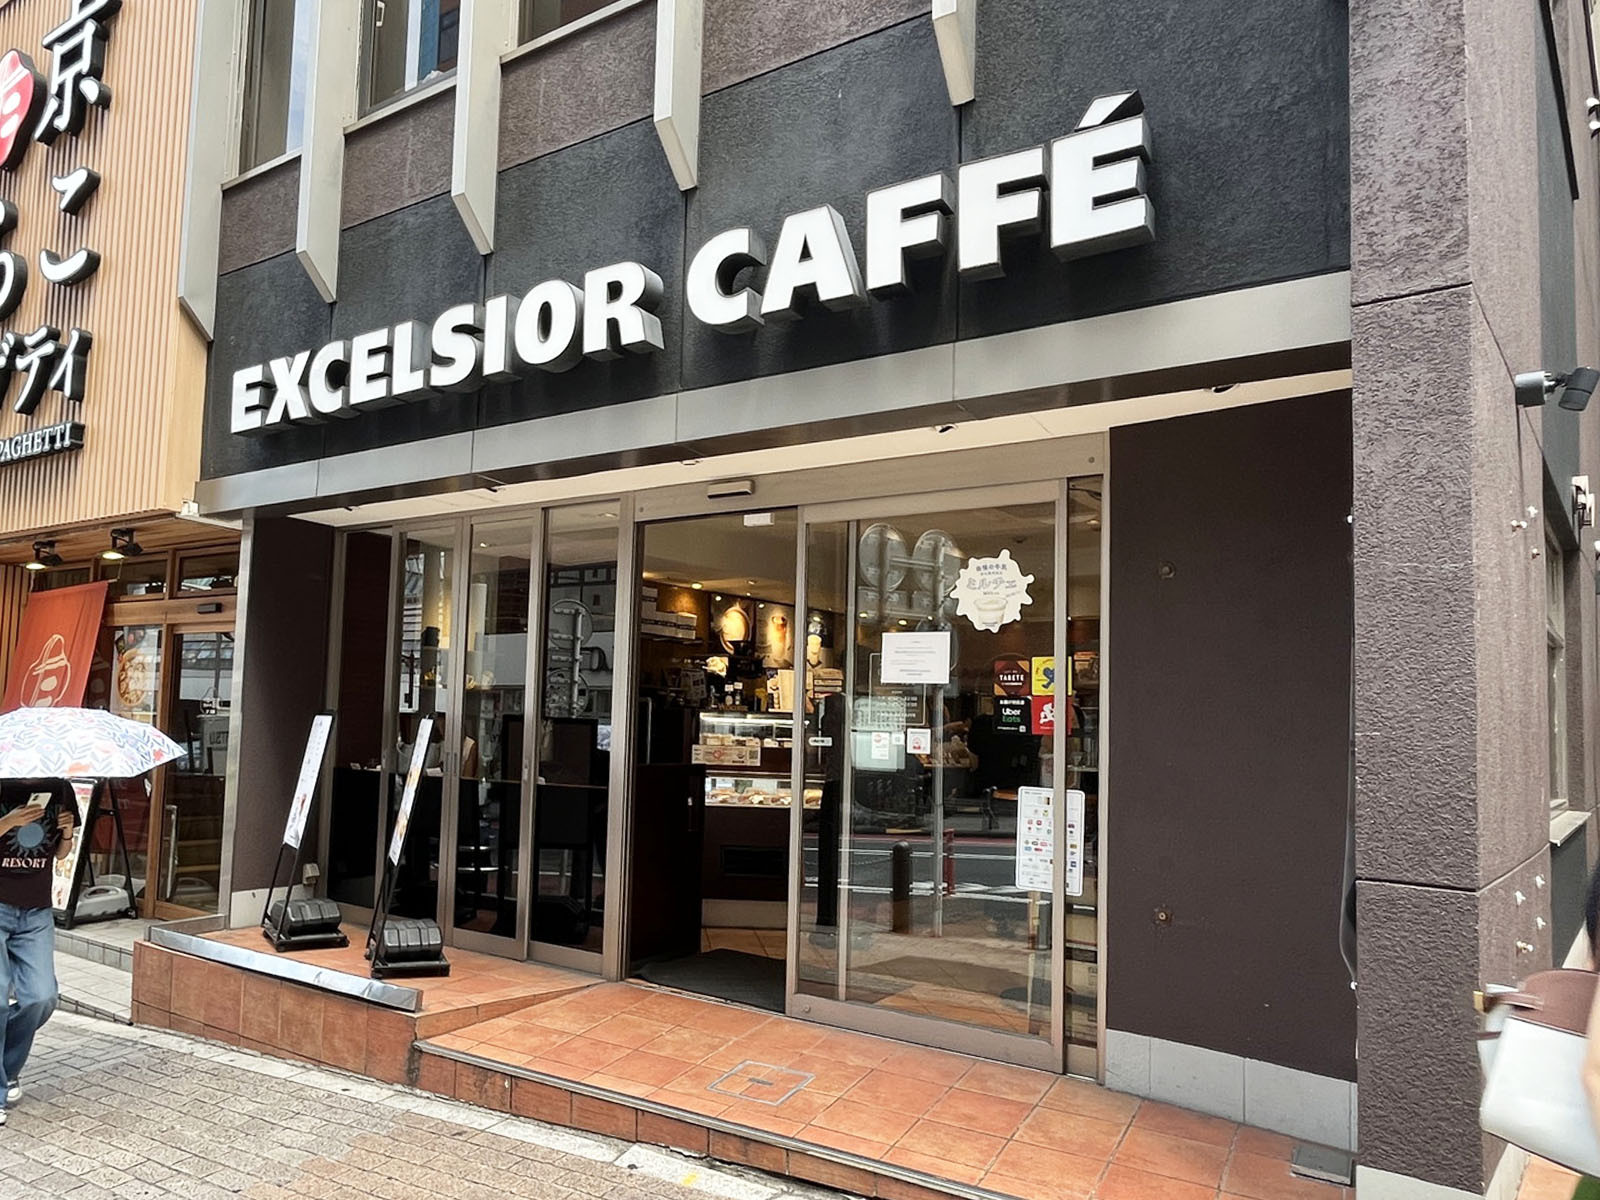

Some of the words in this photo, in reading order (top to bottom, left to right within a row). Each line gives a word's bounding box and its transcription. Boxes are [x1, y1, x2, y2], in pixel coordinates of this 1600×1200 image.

[34, 0, 110, 132] 京
[230, 261, 664, 435] EXCELSIOR
[686, 89, 1154, 326] CAFFÉ
[1002, 707, 1021, 716] Uber
[1, 857, 48, 869] RESORT
